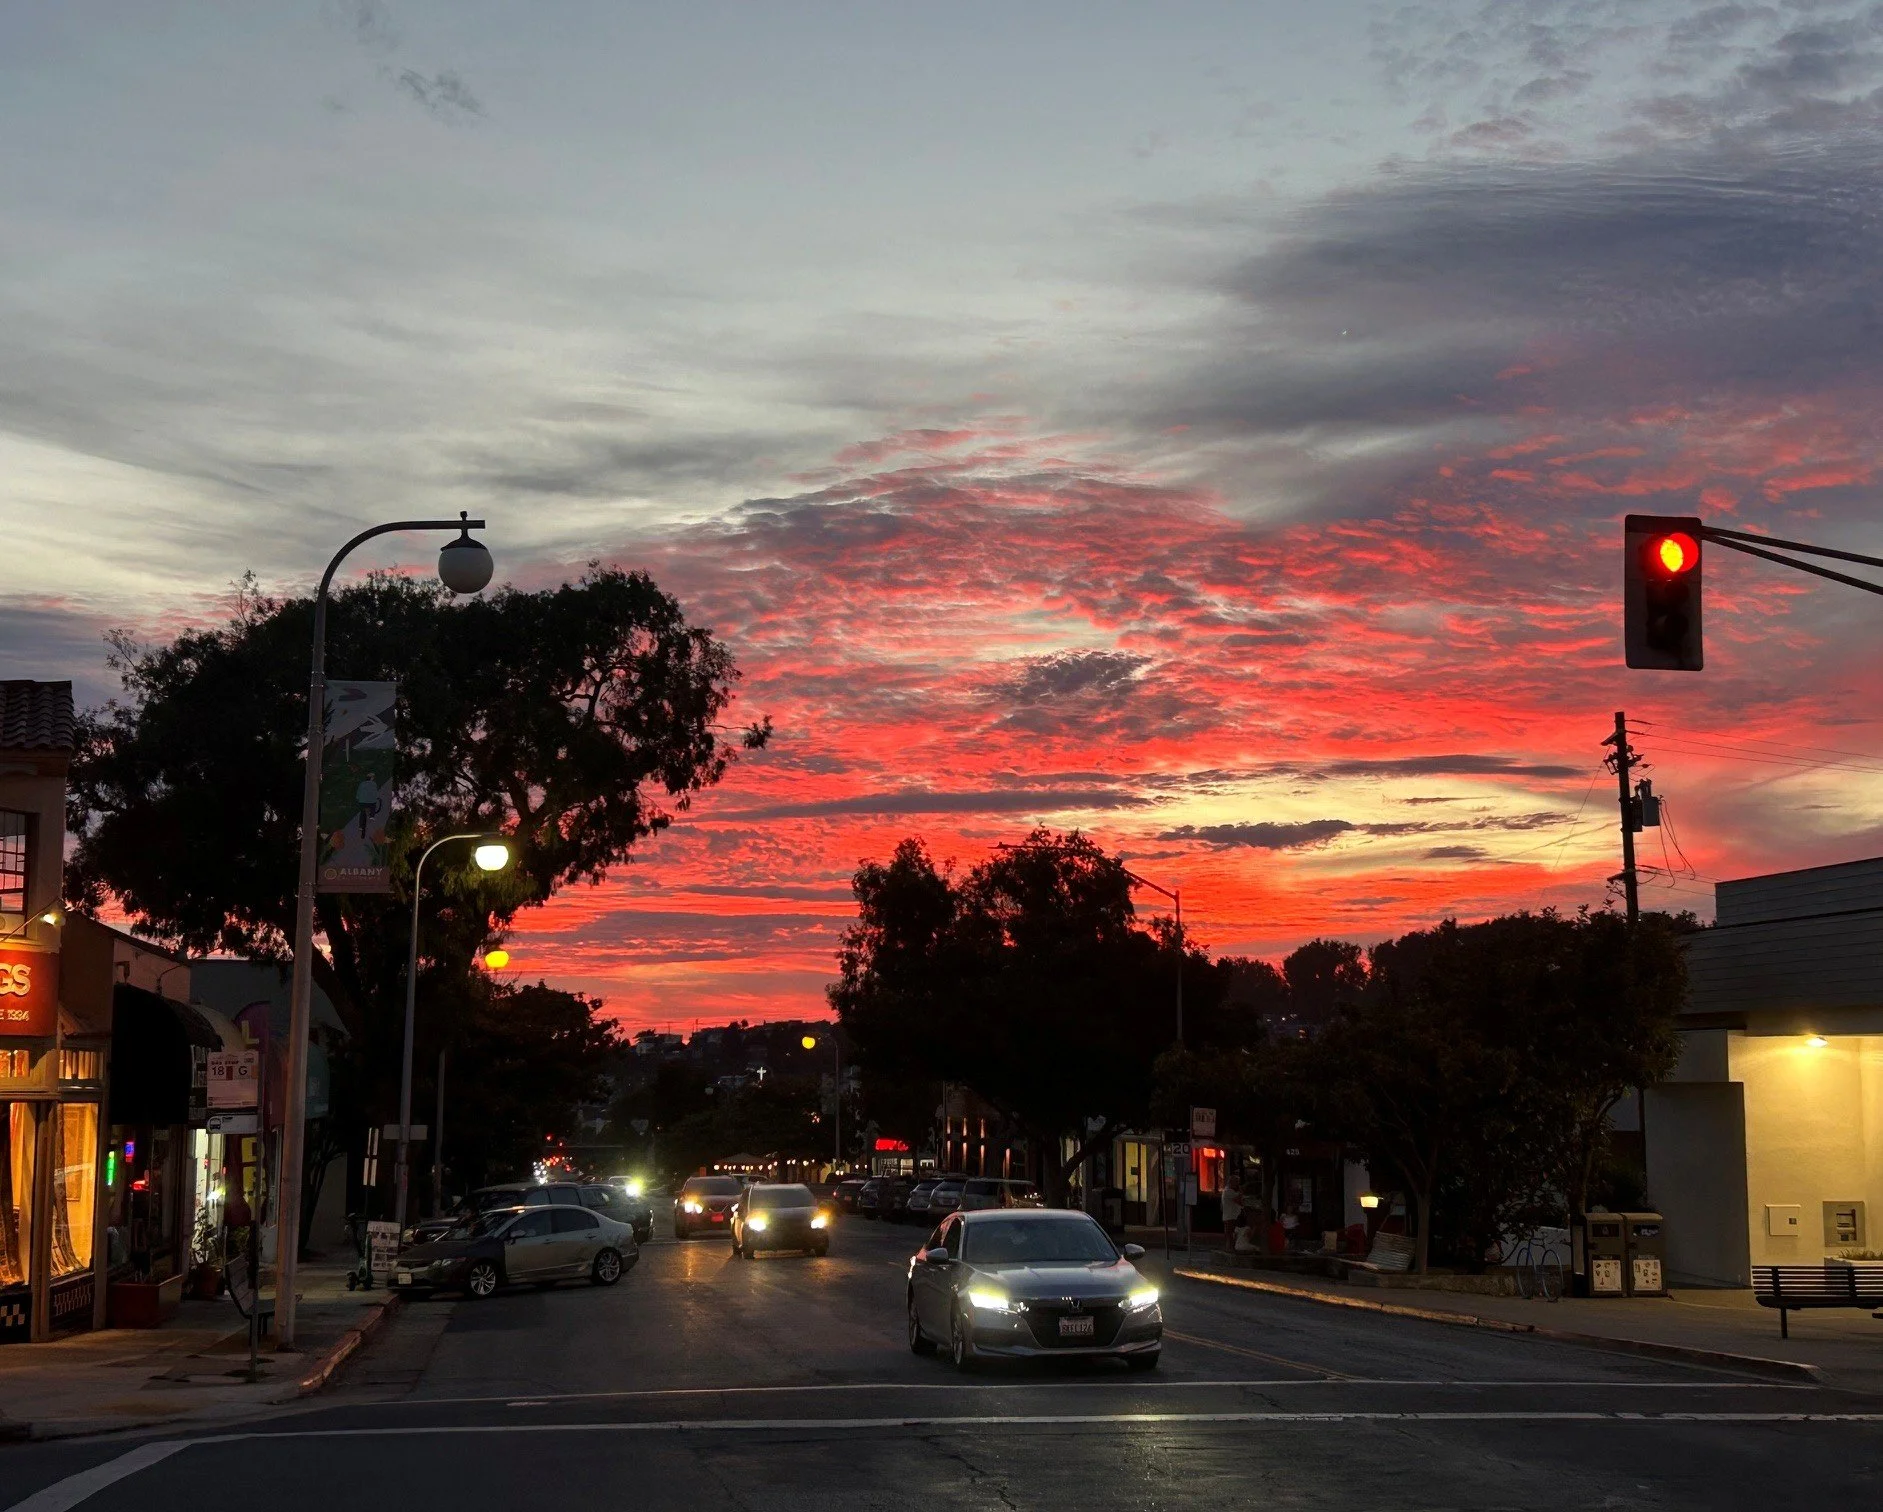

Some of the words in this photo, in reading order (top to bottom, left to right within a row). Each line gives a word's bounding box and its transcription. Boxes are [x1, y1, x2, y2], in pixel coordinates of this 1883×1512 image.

[340, 868, 383, 876] ALBANY
[212, 1065, 225, 1076] 18
[238, 1065, 248, 1076] G
